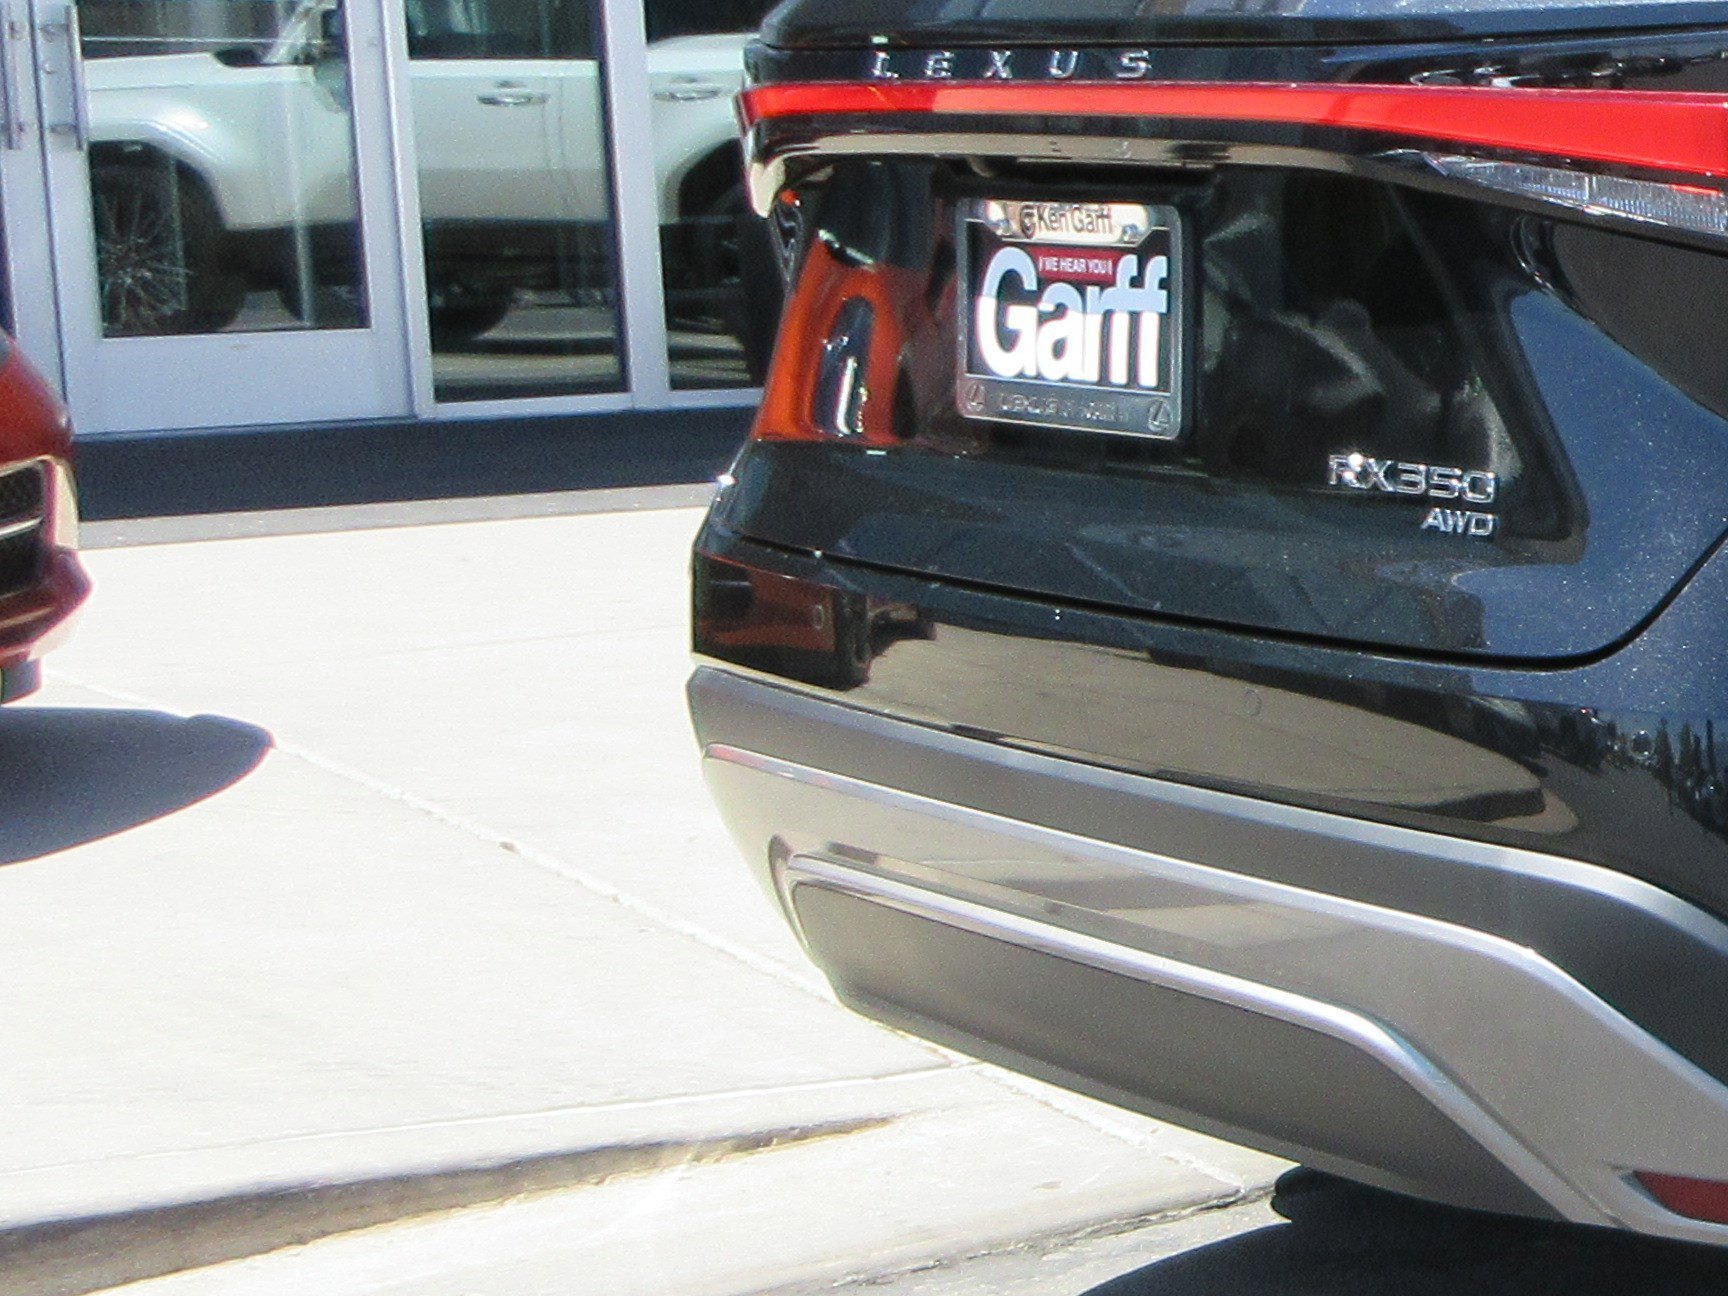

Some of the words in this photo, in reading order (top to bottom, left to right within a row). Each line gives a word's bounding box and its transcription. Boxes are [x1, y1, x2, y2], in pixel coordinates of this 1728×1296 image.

[871, 49, 1152, 81] LEXUS
[977, 246, 1168, 388] Garff
[1420, 507, 1497, 536] AWD
